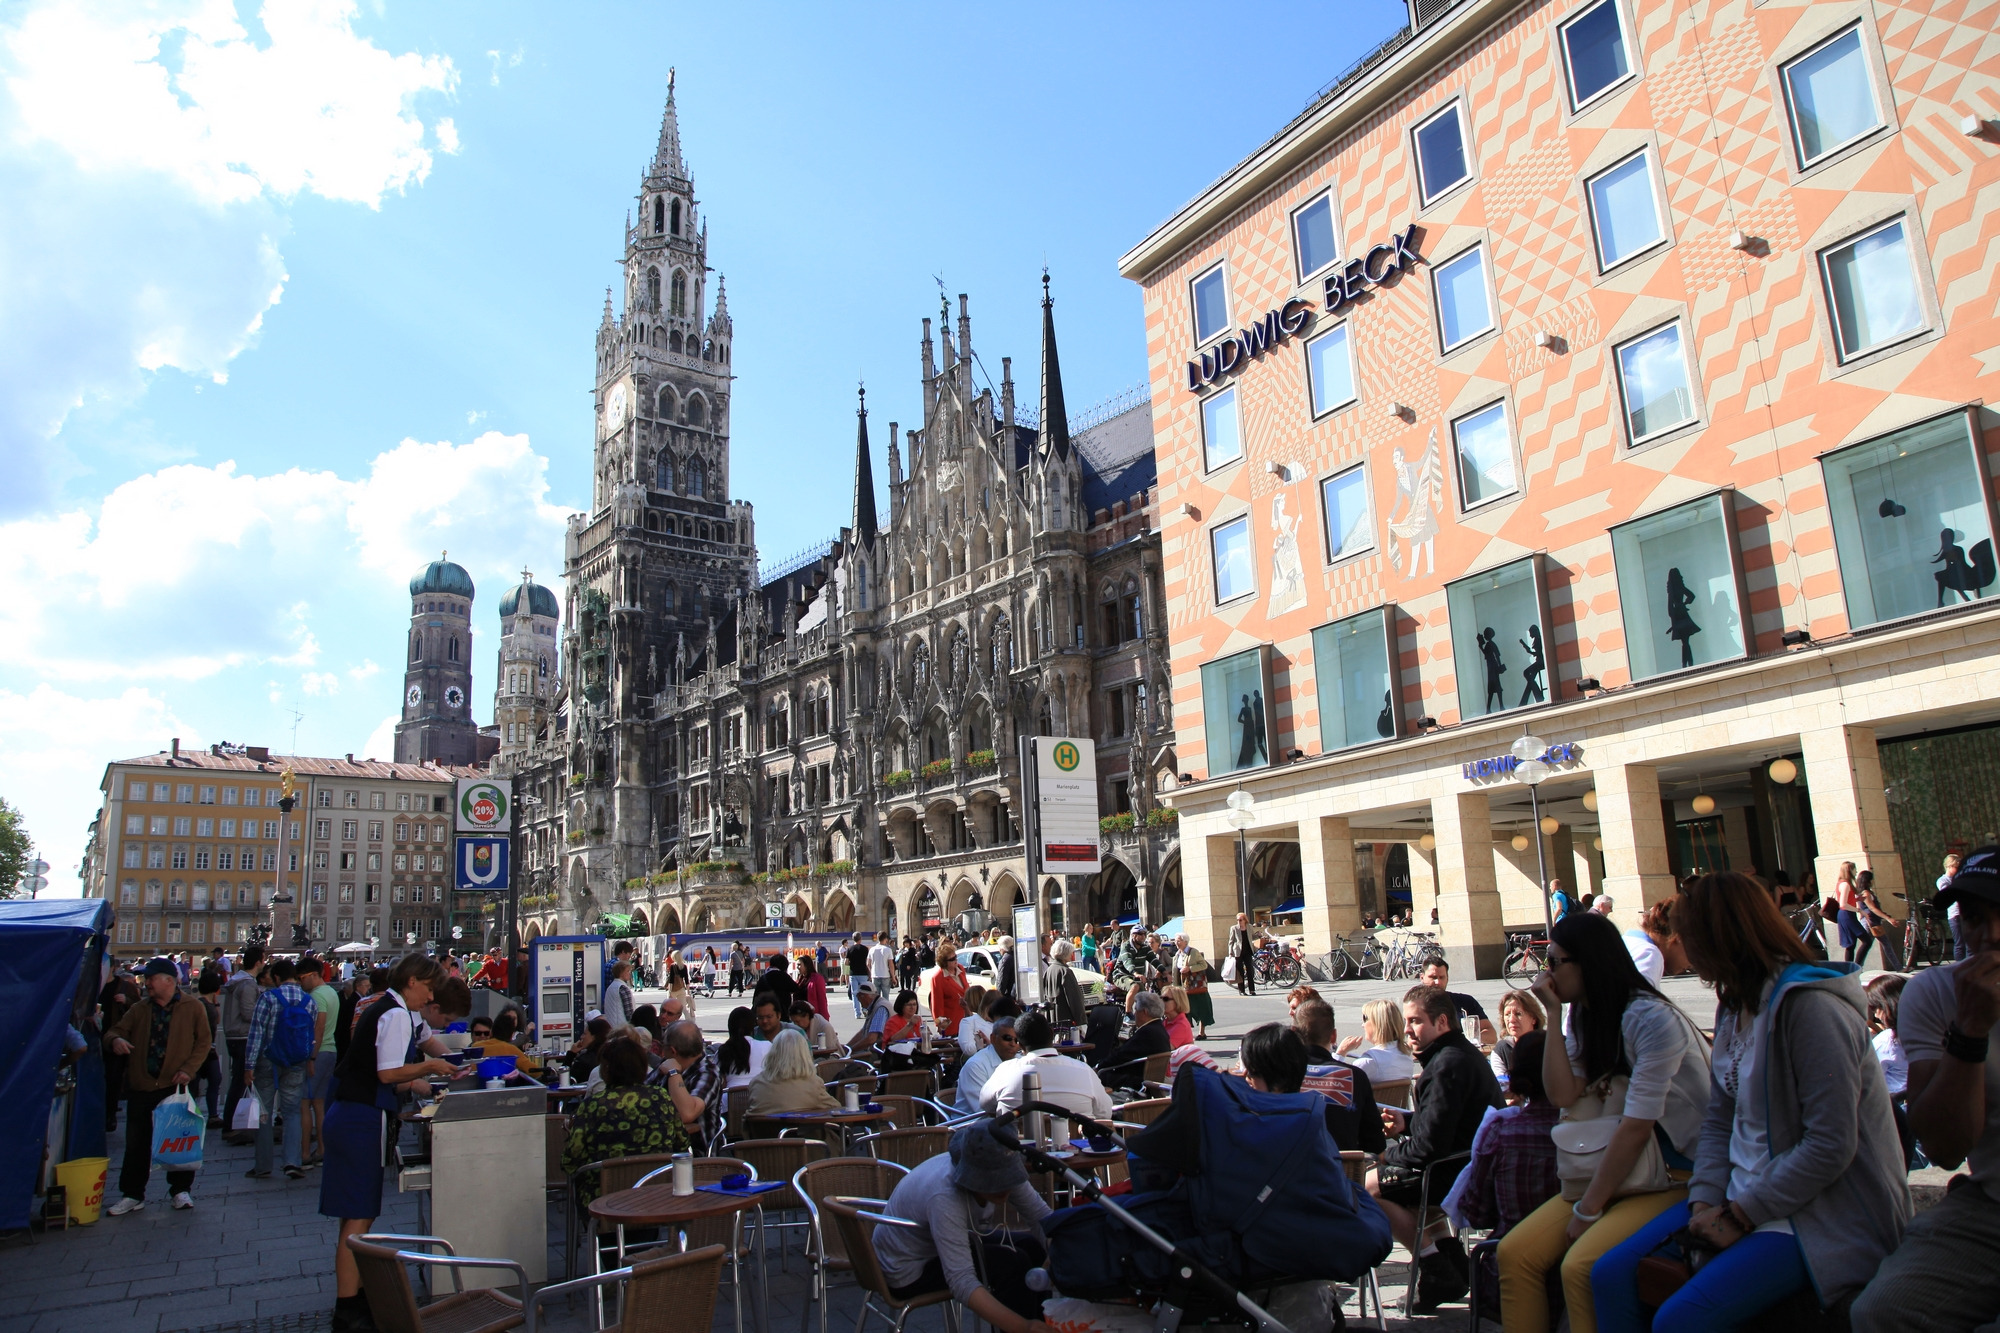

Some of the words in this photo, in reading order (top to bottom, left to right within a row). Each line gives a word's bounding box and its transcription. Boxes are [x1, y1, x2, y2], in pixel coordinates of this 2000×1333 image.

[1187, 296, 1310, 392] LUDWIG
[1322, 224, 1419, 313] BECK
[1536, 742, 1575, 766] CK
[474, 805, 494, 816] 20%
[465, 843, 500, 885] U
[770, 904, 781, 916] S
[575, 957, 583, 982] Tickets
[159, 1136, 199, 1153] HIT
